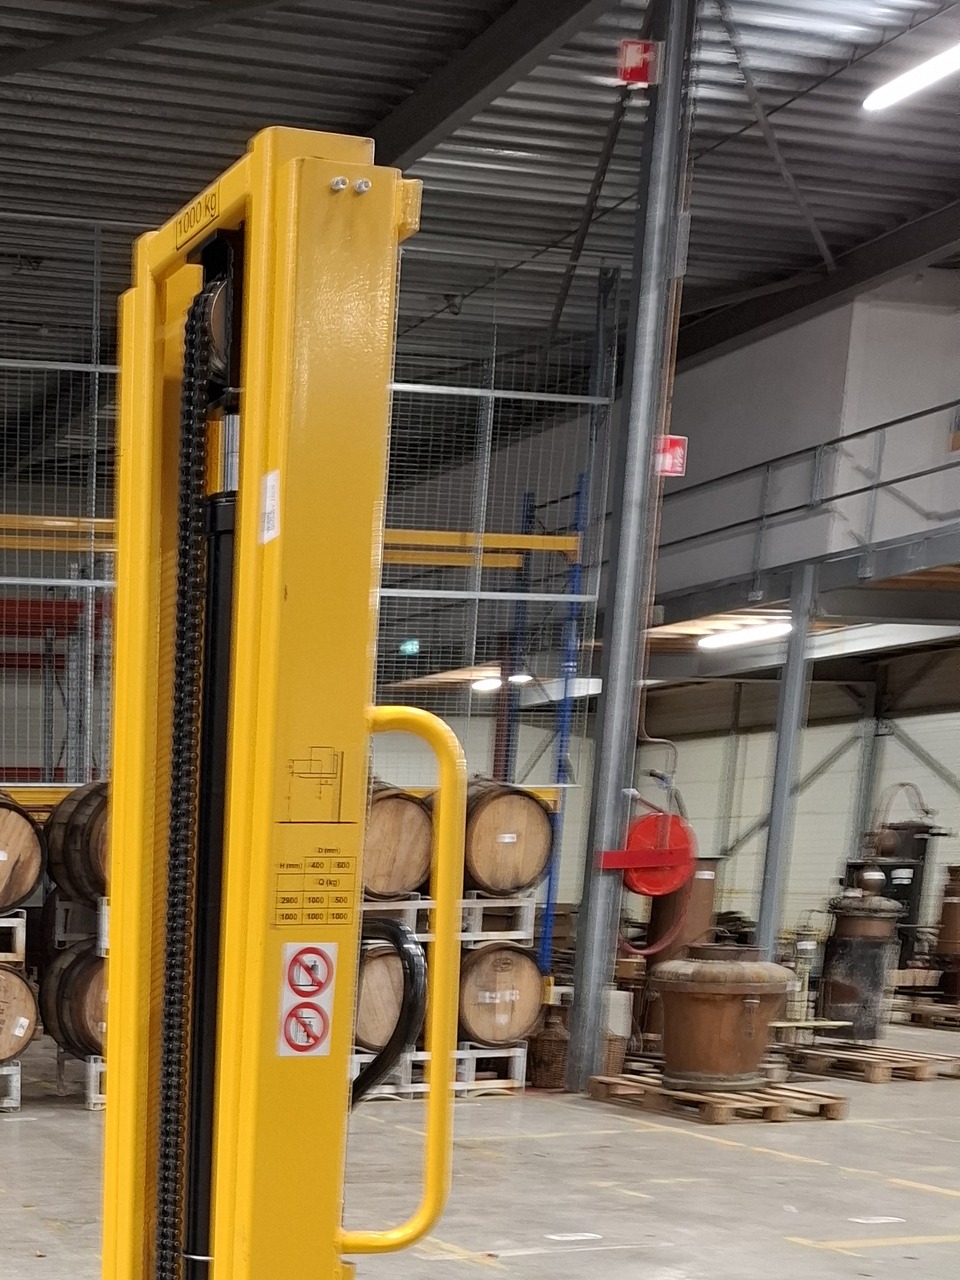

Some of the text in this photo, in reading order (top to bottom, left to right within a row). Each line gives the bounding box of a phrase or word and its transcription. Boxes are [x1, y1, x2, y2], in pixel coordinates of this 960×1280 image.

[178, 192, 217, 237] 1000 kg
[310, 861, 325, 869] 400
